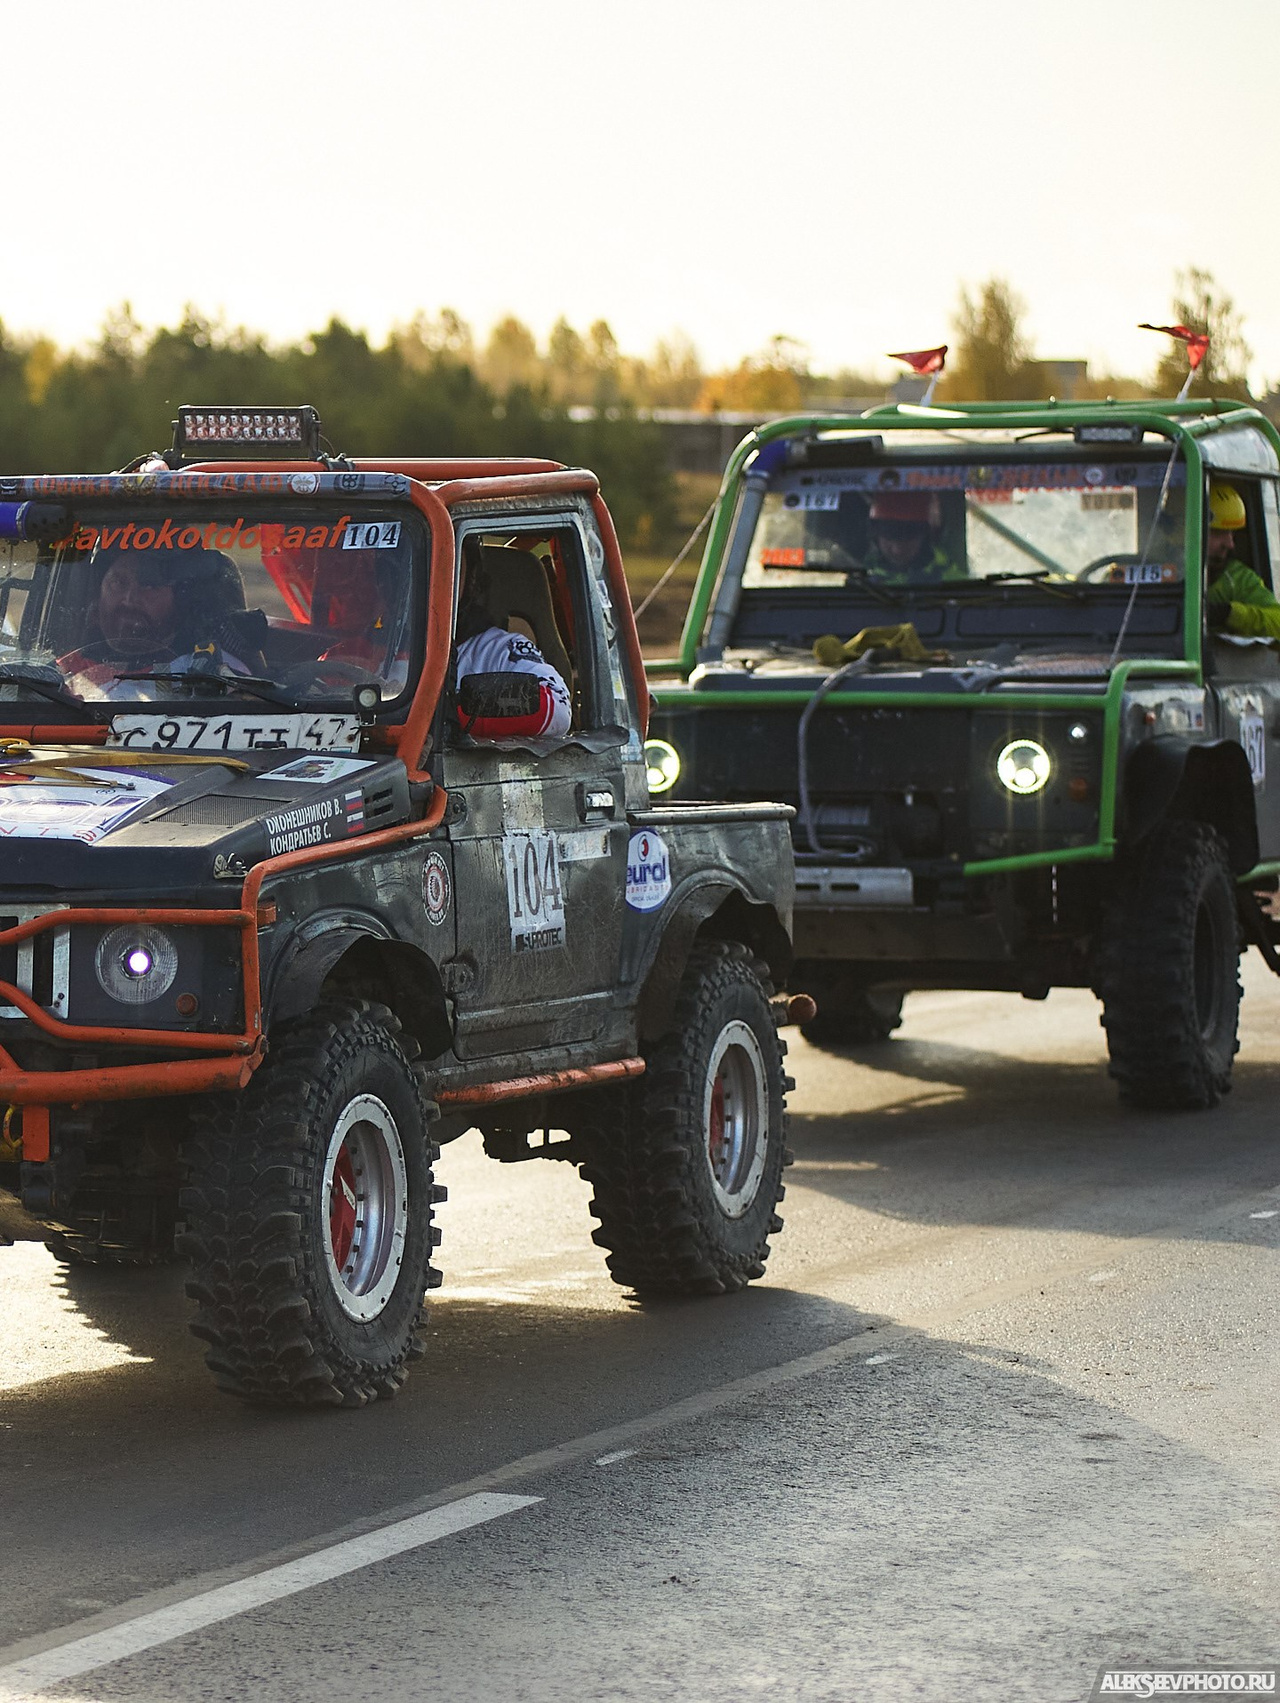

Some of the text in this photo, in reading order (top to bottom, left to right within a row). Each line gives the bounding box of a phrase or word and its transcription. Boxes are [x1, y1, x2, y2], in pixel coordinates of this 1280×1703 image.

[349, 525, 397, 547] 104
[305, 718, 346, 746] 47
[333, 798, 343, 815] В.
[269, 821, 332, 856] КОНДРАТЬЕВ С.
[508, 839, 563, 917] 104
